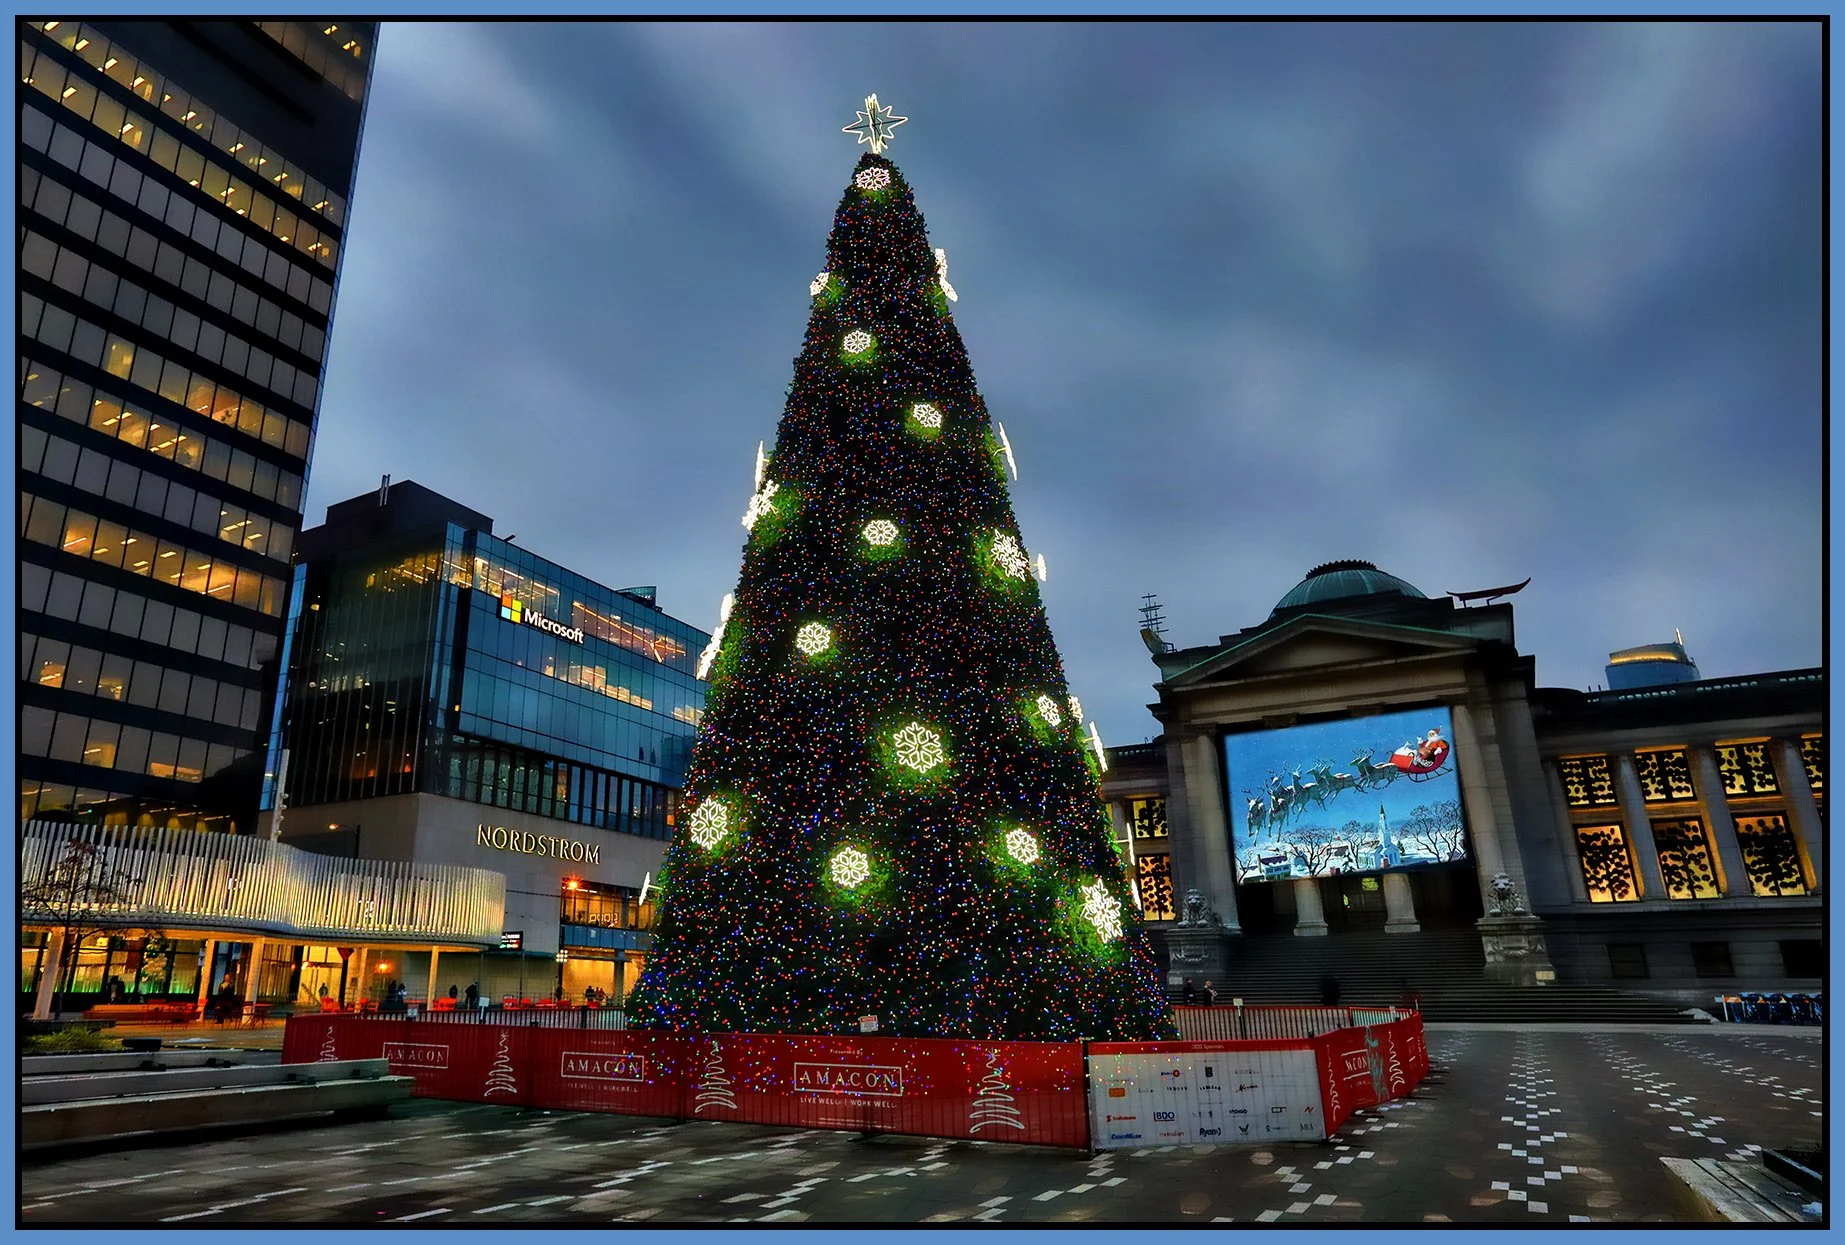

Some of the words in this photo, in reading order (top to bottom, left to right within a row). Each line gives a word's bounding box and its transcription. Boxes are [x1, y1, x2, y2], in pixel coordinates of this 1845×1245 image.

[524, 608, 584, 644] Microsoft
[477, 823, 601, 865] NORDSTROM
[387, 1048, 444, 1063] AMACON
[566, 1058, 639, 1075] AMACON
[800, 1070, 896, 1088] AMACON
[800, 1096, 817, 1104] LIVE
[850, 1099, 872, 1107] WORK
[1156, 1111, 1175, 1120] BDO
[1199, 1127, 1216, 1138] Ryan
